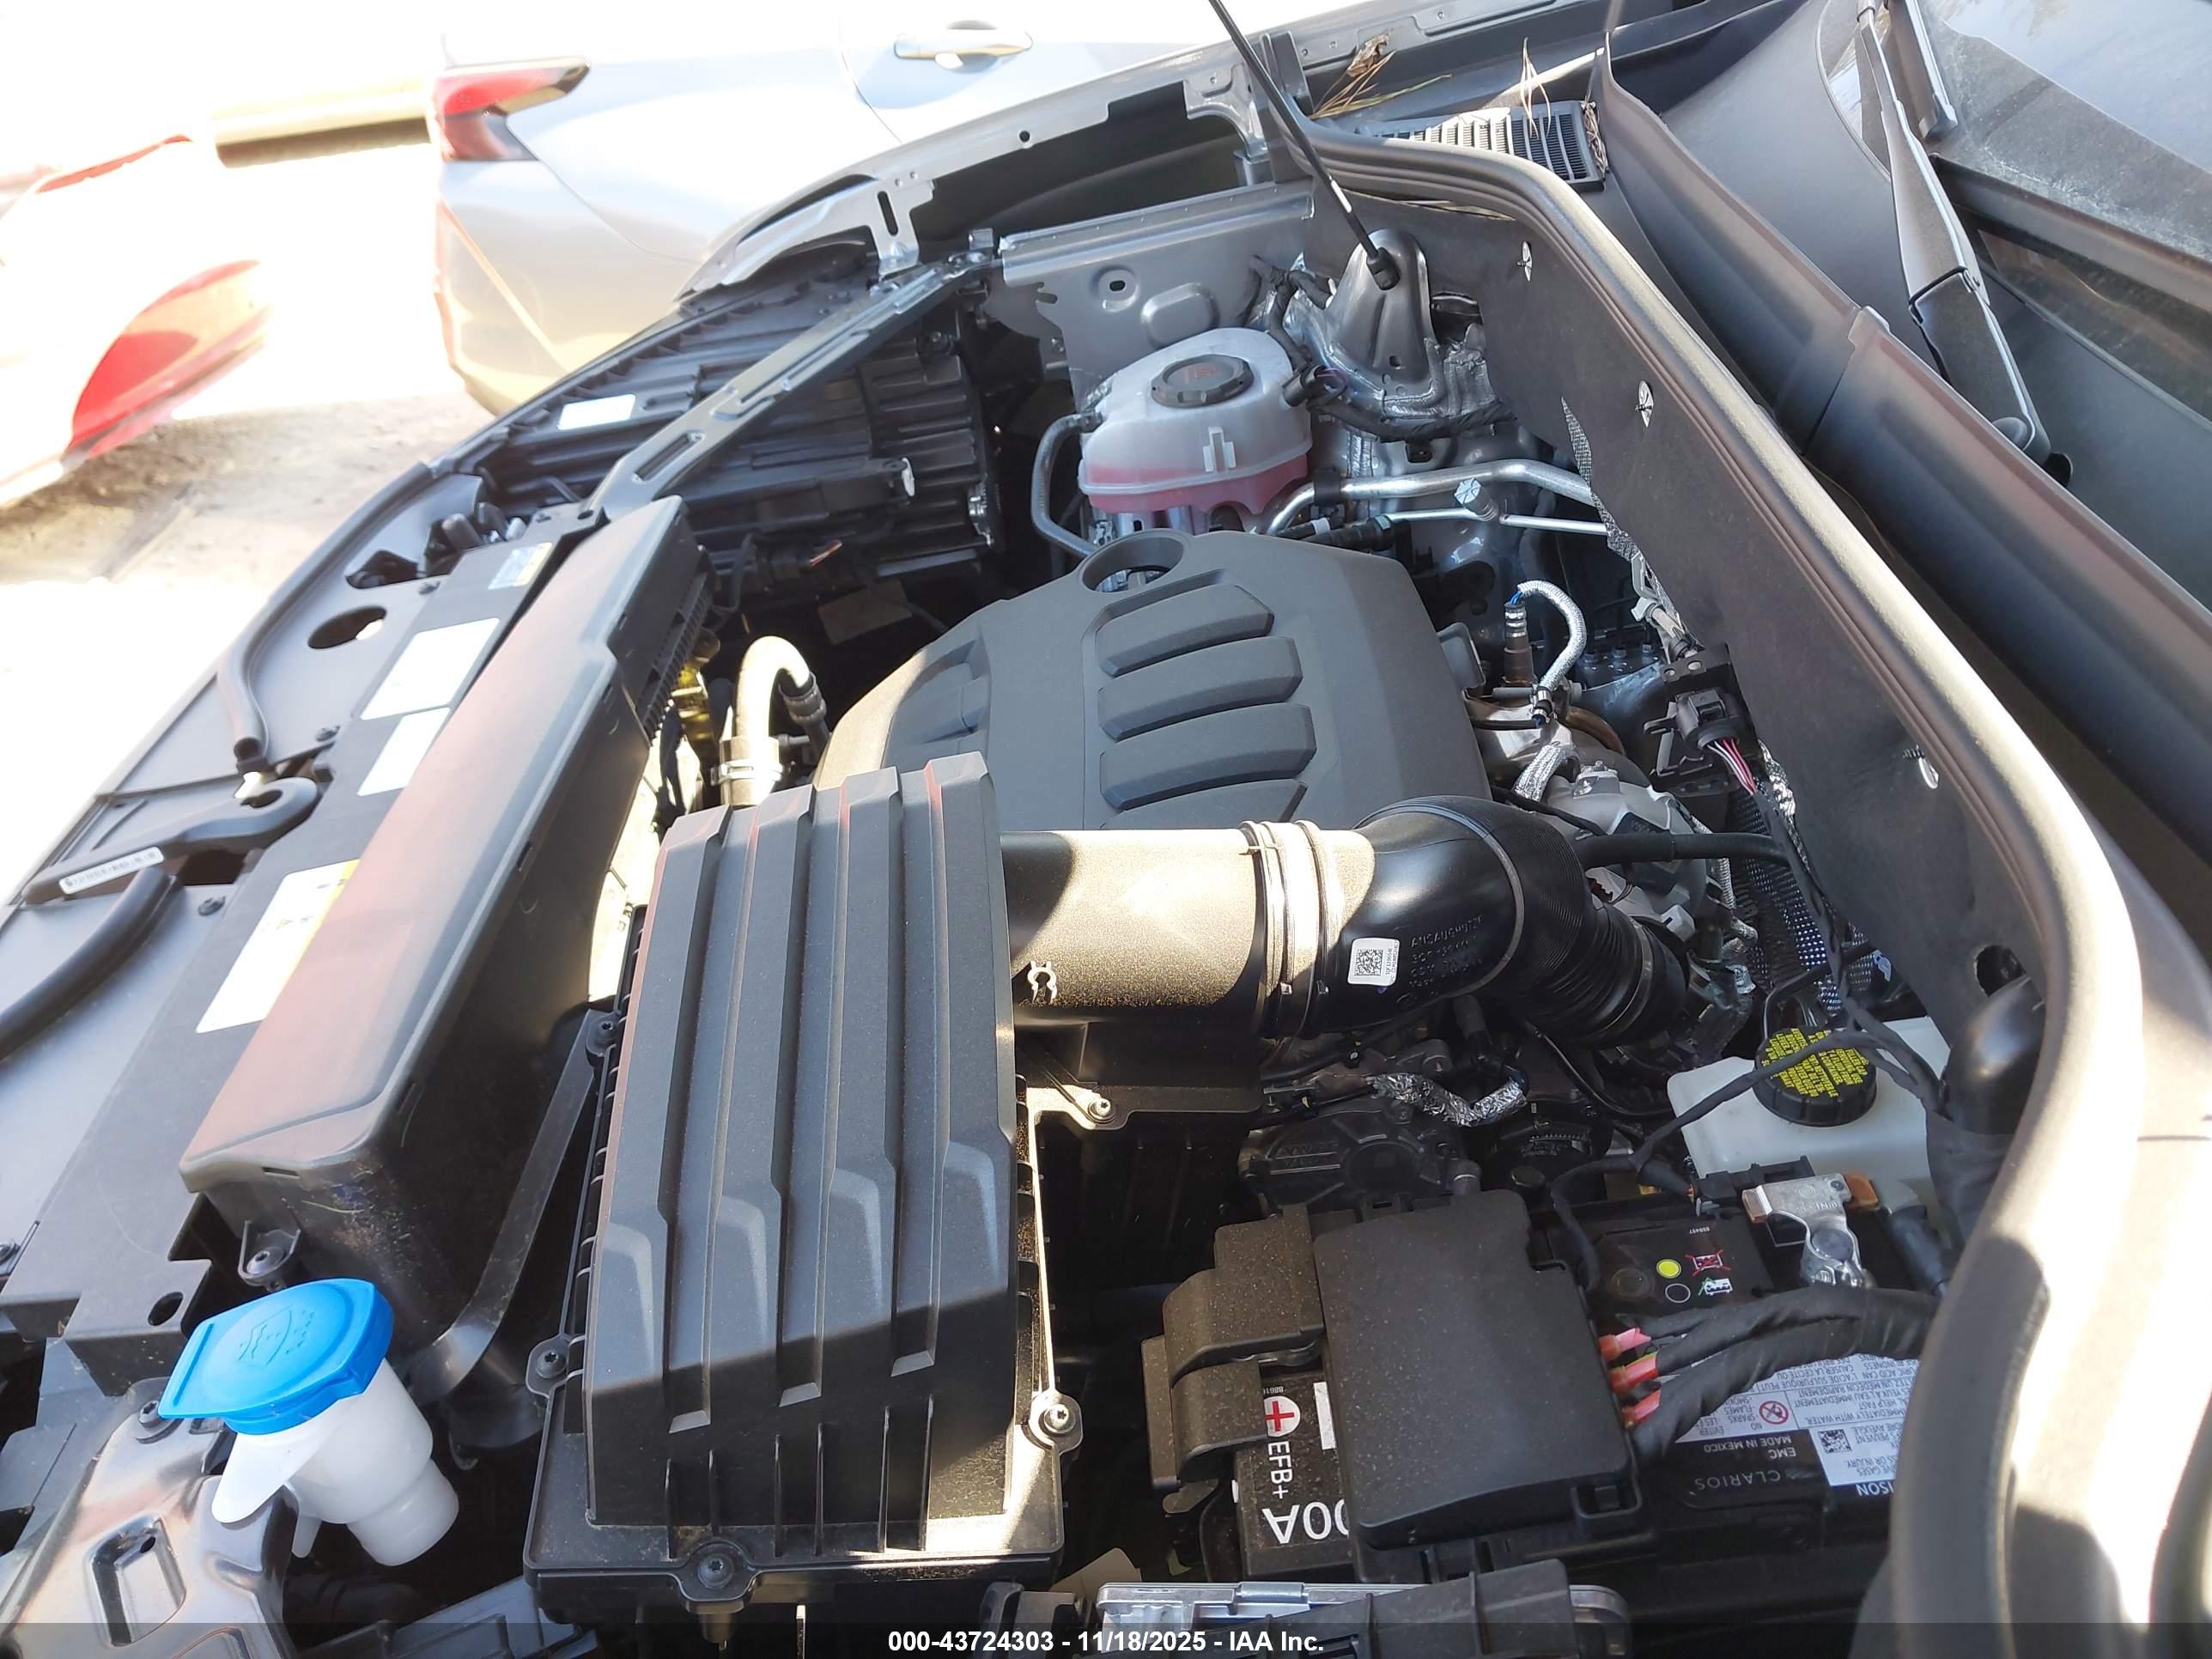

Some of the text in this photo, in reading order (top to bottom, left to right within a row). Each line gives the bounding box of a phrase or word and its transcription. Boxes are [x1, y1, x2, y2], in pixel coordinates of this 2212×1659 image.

[1704, 1435, 1791, 1453] MADE IN MEXICO
[1769, 1447, 1796, 1459] EMC
[1267, 1440, 1293, 1499] EFB+
[1694, 1469, 1781, 1491] CLARIOS
